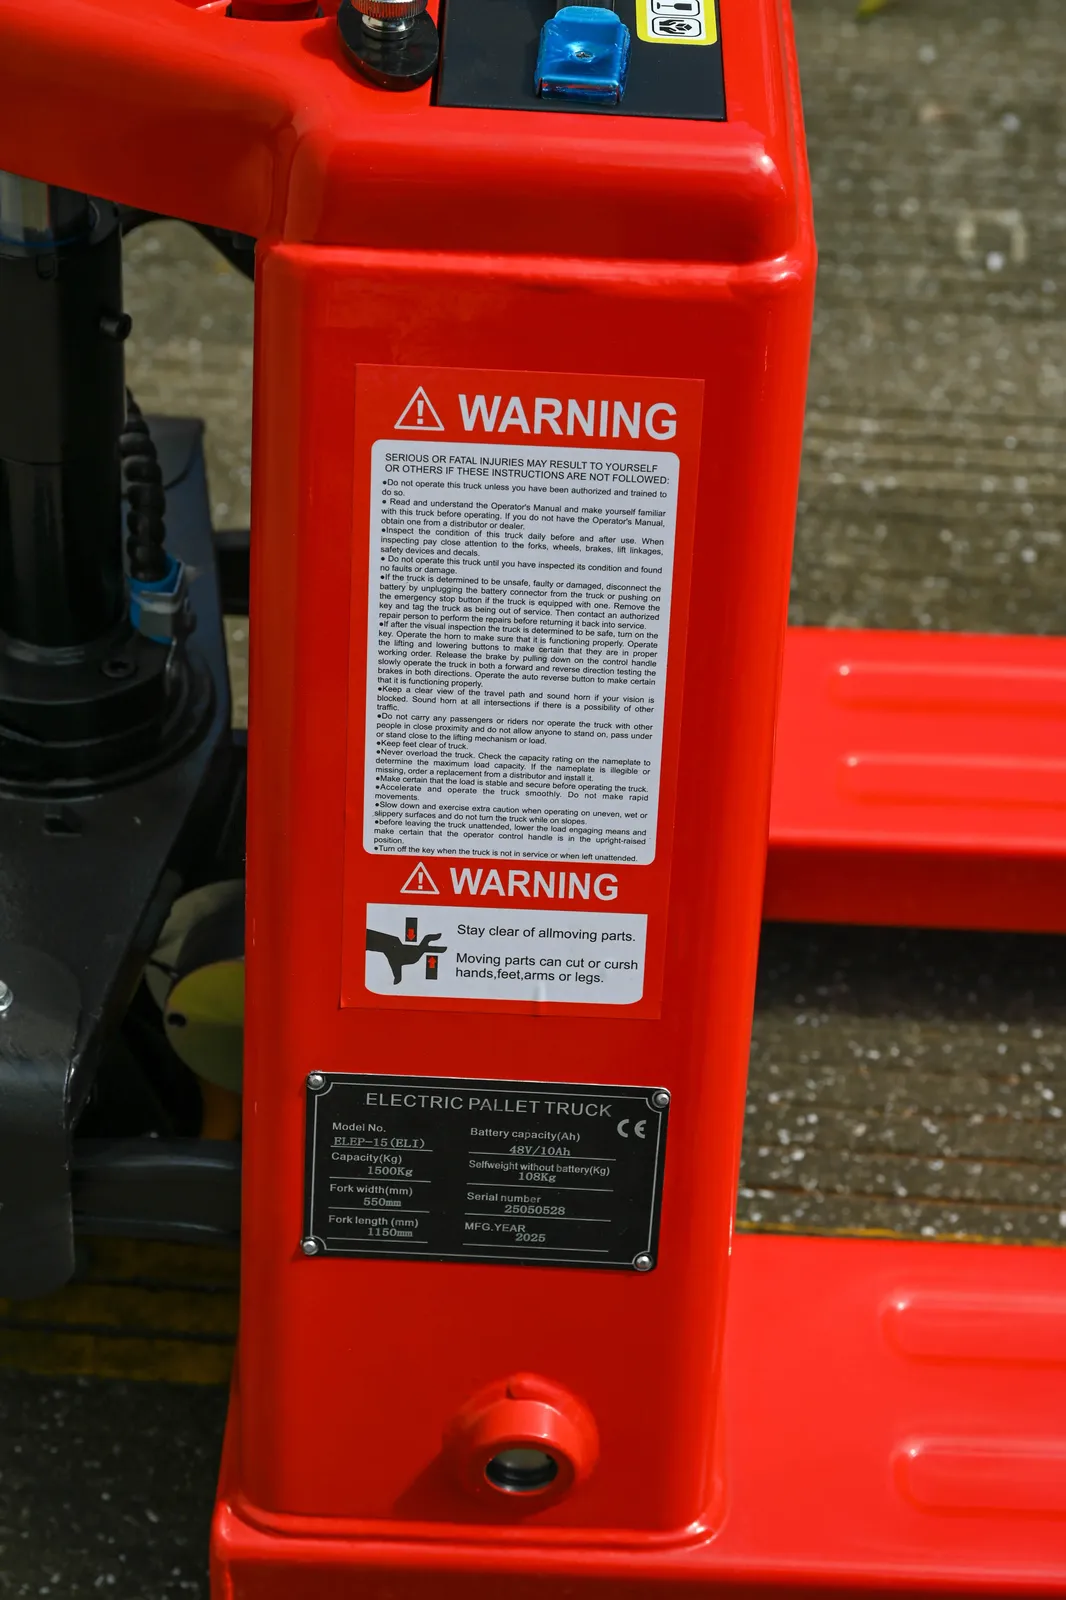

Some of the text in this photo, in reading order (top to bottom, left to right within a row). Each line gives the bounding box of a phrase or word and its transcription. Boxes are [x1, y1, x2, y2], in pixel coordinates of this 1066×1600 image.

[458, 394, 678, 441] WARNING
[385, 453, 658, 473] SERIOUS OR FATAL INJURIES MAY RESULT TO YOURSELF
[385, 464, 670, 485] OR OTHERS IF THESE INSTRUCTIONS ARE NOT FOLLOWED:
[399, 508, 414, 516] this
[416, 509, 435, 517] truck
[437, 509, 462, 518] before
[464, 512, 502, 522] operating.
[505, 512, 511, 520] If
[512, 514, 527, 522] you
[556, 515, 575, 523] have
[578, 516, 590, 524] the
[592, 516, 633, 526] Operator's
[635, 518, 665, 528] Manual,
[380, 546, 480, 557] safety devices and decals.
[381, 536, 420, 546] inspecting
[423, 539, 438, 547] pay
[440, 539, 461, 547] close
[464, 540, 498, 548] attention
[501, 541, 509, 549] to
[528, 542, 549, 551] forks,
[552, 544, 582, 552] wheels,
[586, 545, 614, 554] brakes,
[617, 546, 626, 554] lift
[630, 547, 664, 557] linkages,
[380, 583, 407, 593] battery
[409, 584, 419, 593] by
[421, 585, 463, 595] unplugging
[481, 587, 508, 597] battery
[550, 590, 568, 598] from
[570, 591, 583, 599] the
[586, 592, 605, 600] truck
[618, 594, 648, 603] pushing
[378, 639, 391, 647] the
[394, 640, 414, 649] lifting
[436, 642, 468, 652] lowering
[471, 643, 500, 651] buttons
[503, 644, 511, 652] to
[514, 645, 535, 653] make
[538, 646, 564, 654] certain
[568, 647, 583, 655] that
[586, 648, 603, 657] they
[633, 651, 658, 659] proper
[377, 694, 408, 703] blocked.
[412, 696, 437, 704] Sound
[440, 697, 457, 705] horn
[484, 699, 531, 708] intersections
[566, 702, 572, 710] is
[584, 704, 621, 713] possibility
[376, 757, 413, 766] determine
[433, 760, 470, 768] maximum
[474, 761, 490, 769] load
[494, 763, 526, 772] capacity.
[600, 766, 606, 774] is
[610, 767, 639, 776] illegible
[447, 830, 459, 838] the
[558, 834, 564, 842] is
[596, 836, 646, 846] upright-raised
[450, 867, 619, 901] WARNING
[457, 924, 636, 943] Stay clear of allmoving parts.
[456, 953, 638, 971] Moving parts can cut or cursh
[456, 967, 604, 984] hands,feet,arms or legs.
[366, 1093, 612, 1118] ELECTRIC PALLET TRUCK
[332, 1122, 386, 1133] Model No.
[470, 1127, 581, 1143] Battery capacity(Ah)
[334, 1136, 425, 1149] ELEP-15(ELI)
[331, 1152, 403, 1165] Capacity(Kg)
[510, 1145, 571, 1157] 48V/10Ah
[368, 1166, 413, 1178] 1500Kg
[469, 1160, 610, 1177] Selfweight without battery(Kg)
[519, 1172, 557, 1184] 108Kg
[330, 1184, 413, 1197] Fork width(mm)
[467, 1193, 541, 1204] Serial number
[364, 1197, 402, 1207] 550mm
[505, 1205, 566, 1216] 25050528
[329, 1216, 419, 1228] Fork length (mm)
[465, 1223, 526, 1234] MFG.YEAR
[368, 1228, 413, 1238] 1150mm
[516, 1233, 546, 1243] 2025
